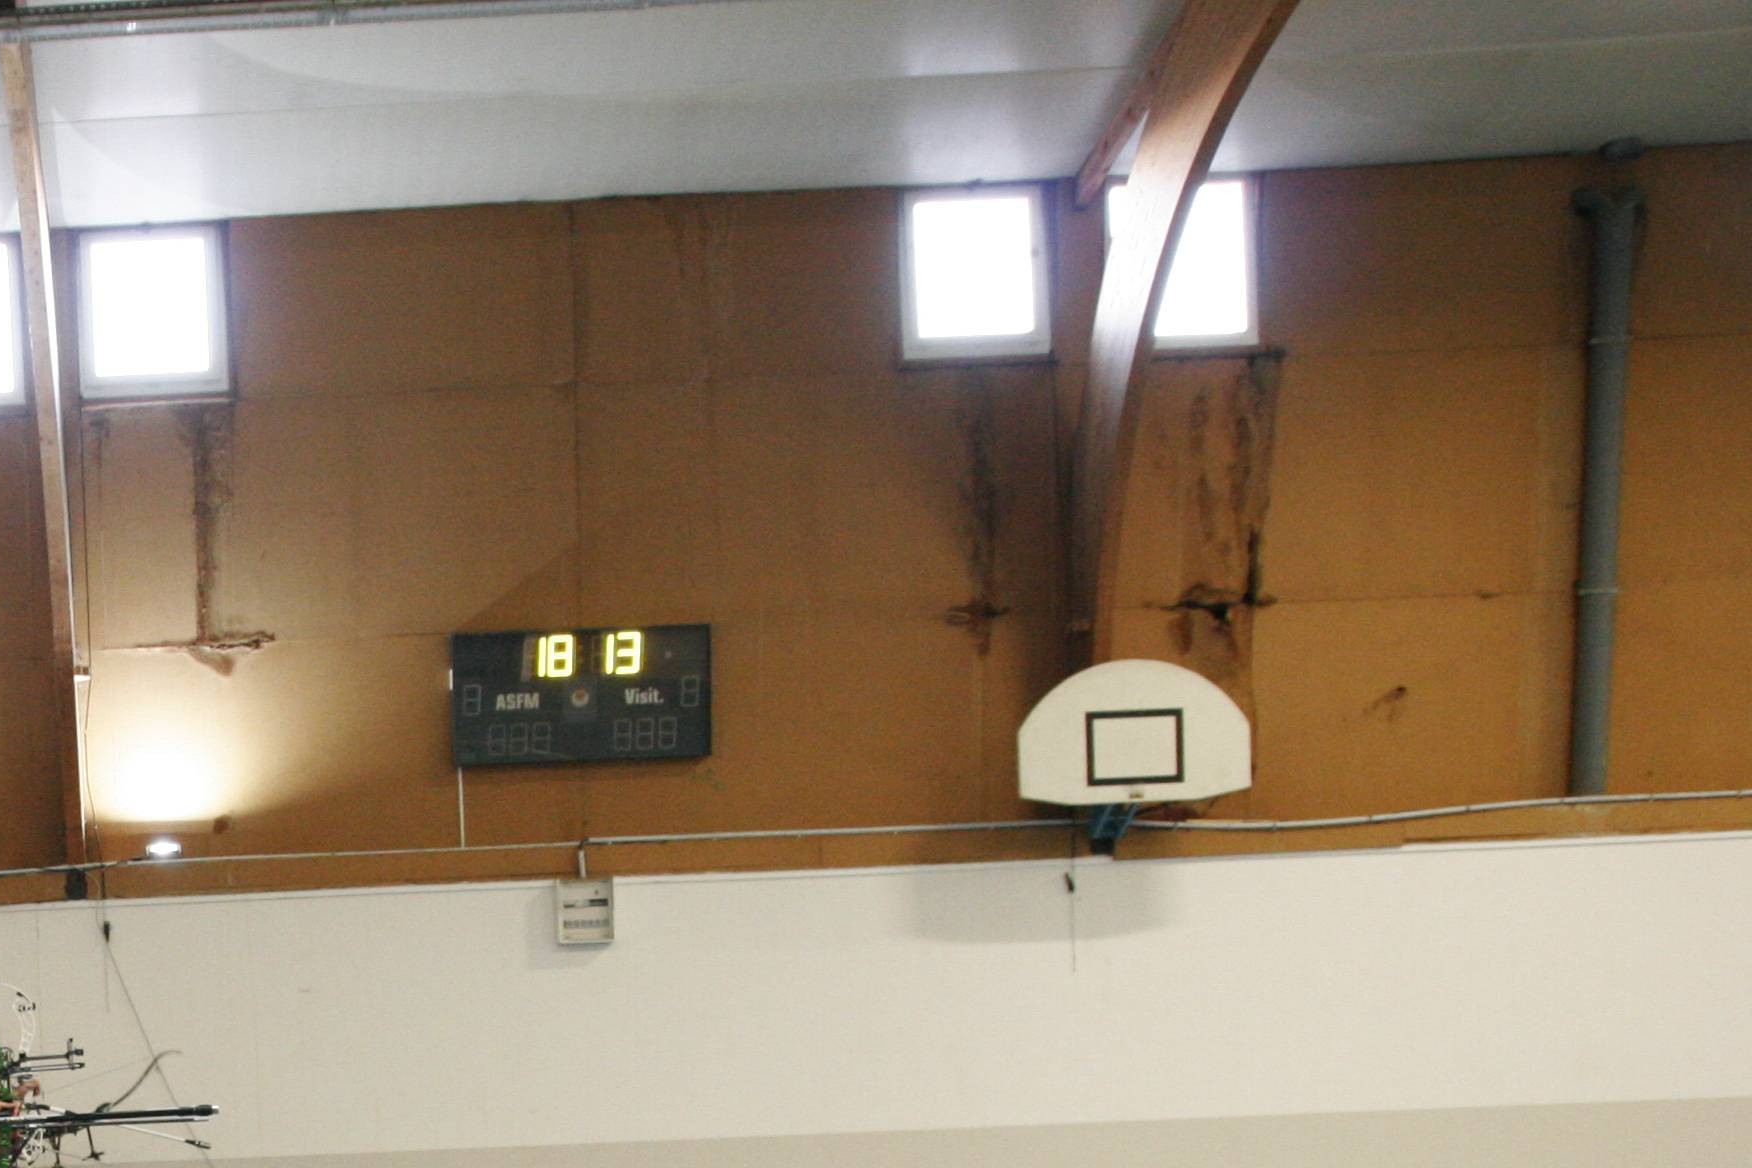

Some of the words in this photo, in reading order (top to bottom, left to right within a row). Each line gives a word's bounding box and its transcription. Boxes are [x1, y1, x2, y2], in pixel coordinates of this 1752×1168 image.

[537, 633, 574, 678] 18
[605, 631, 641, 675] 13
[496, 692, 540, 711] ASFM
[624, 687, 664, 705] Visit.
